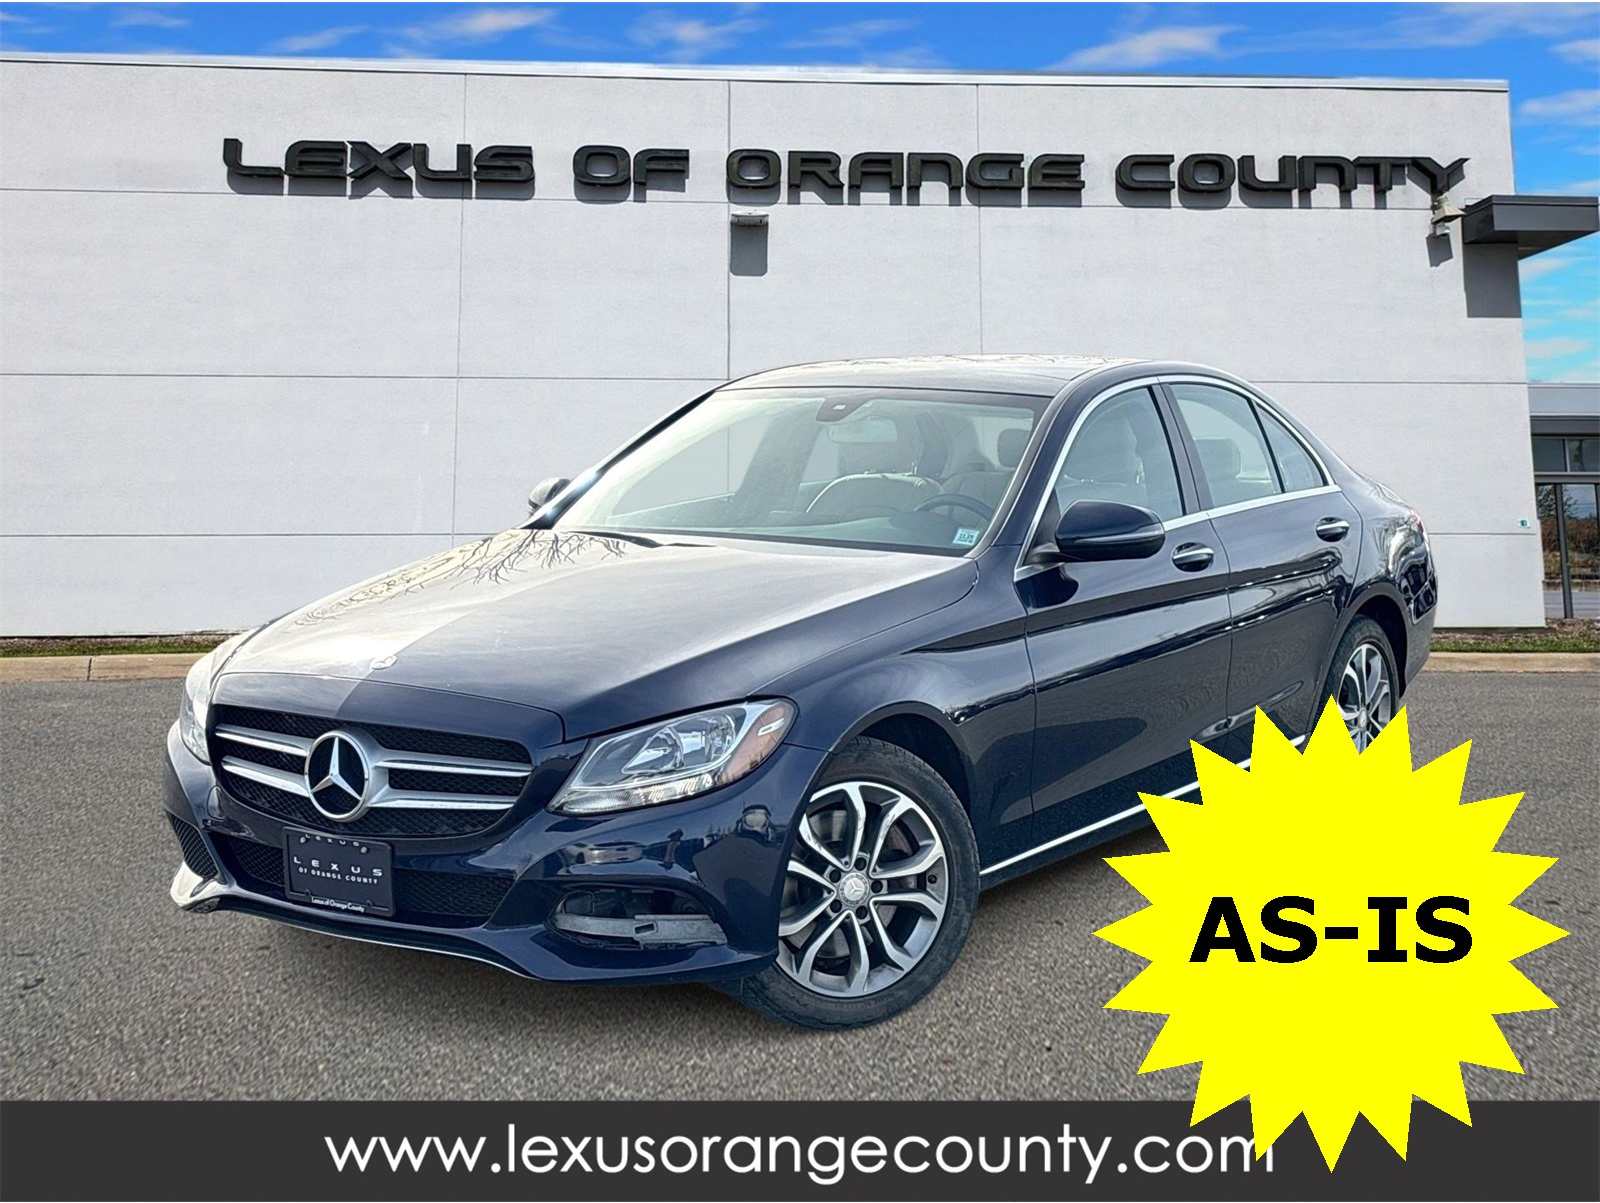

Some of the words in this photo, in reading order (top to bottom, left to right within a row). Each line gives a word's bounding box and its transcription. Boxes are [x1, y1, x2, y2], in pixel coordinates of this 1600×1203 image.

[222, 137, 534, 186] LEXUS
[573, 145, 690, 188] OF
[726, 148, 1085, 191] ORANGE
[1115, 153, 1470, 195] COUNTY
[293, 856, 383, 877] LEXUS
[311, 869, 342, 880] ORANGE
[345, 874, 378, 884] COUNTY
